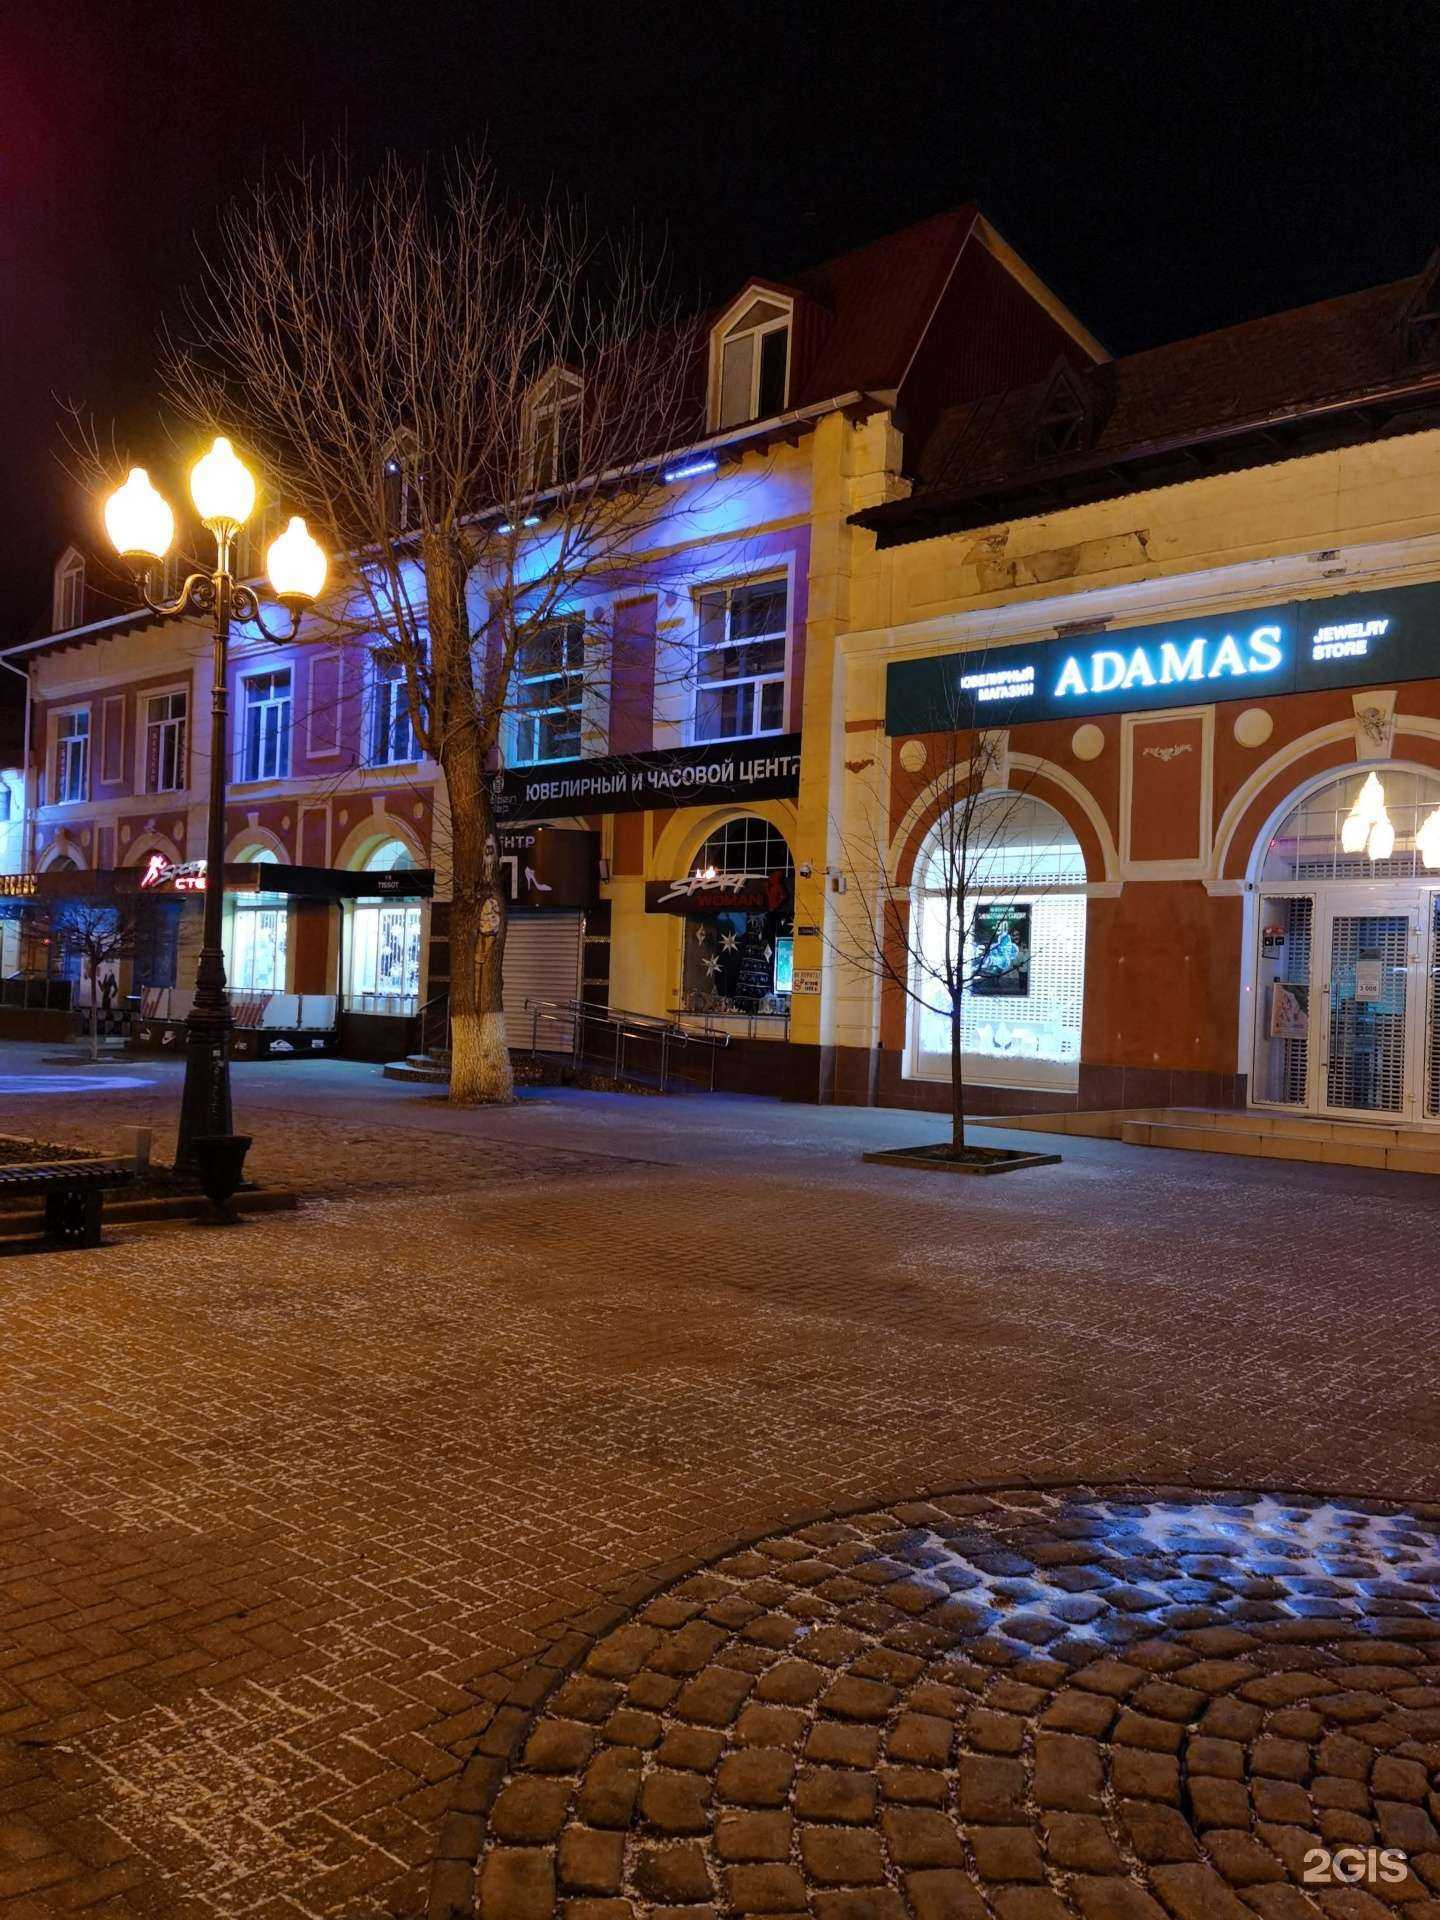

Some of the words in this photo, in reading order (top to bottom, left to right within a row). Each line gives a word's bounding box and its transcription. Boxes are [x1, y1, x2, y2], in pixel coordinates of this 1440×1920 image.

[1313, 619, 1389, 643] JEWELRY
[1054, 625, 1282, 697] ADAMAS
[1312, 639, 1368, 660] STORE
[978, 683, 1034, 701] МАГАЗИН
[526, 774, 627, 802] ЮВЕЛИРНЫЙ
[632, 776, 643, 791] И
[648, 759, 734, 789] ЧАСОВОЙ
[657, 873, 770, 903] SPORT
[697, 894, 763, 906] WOMAN
